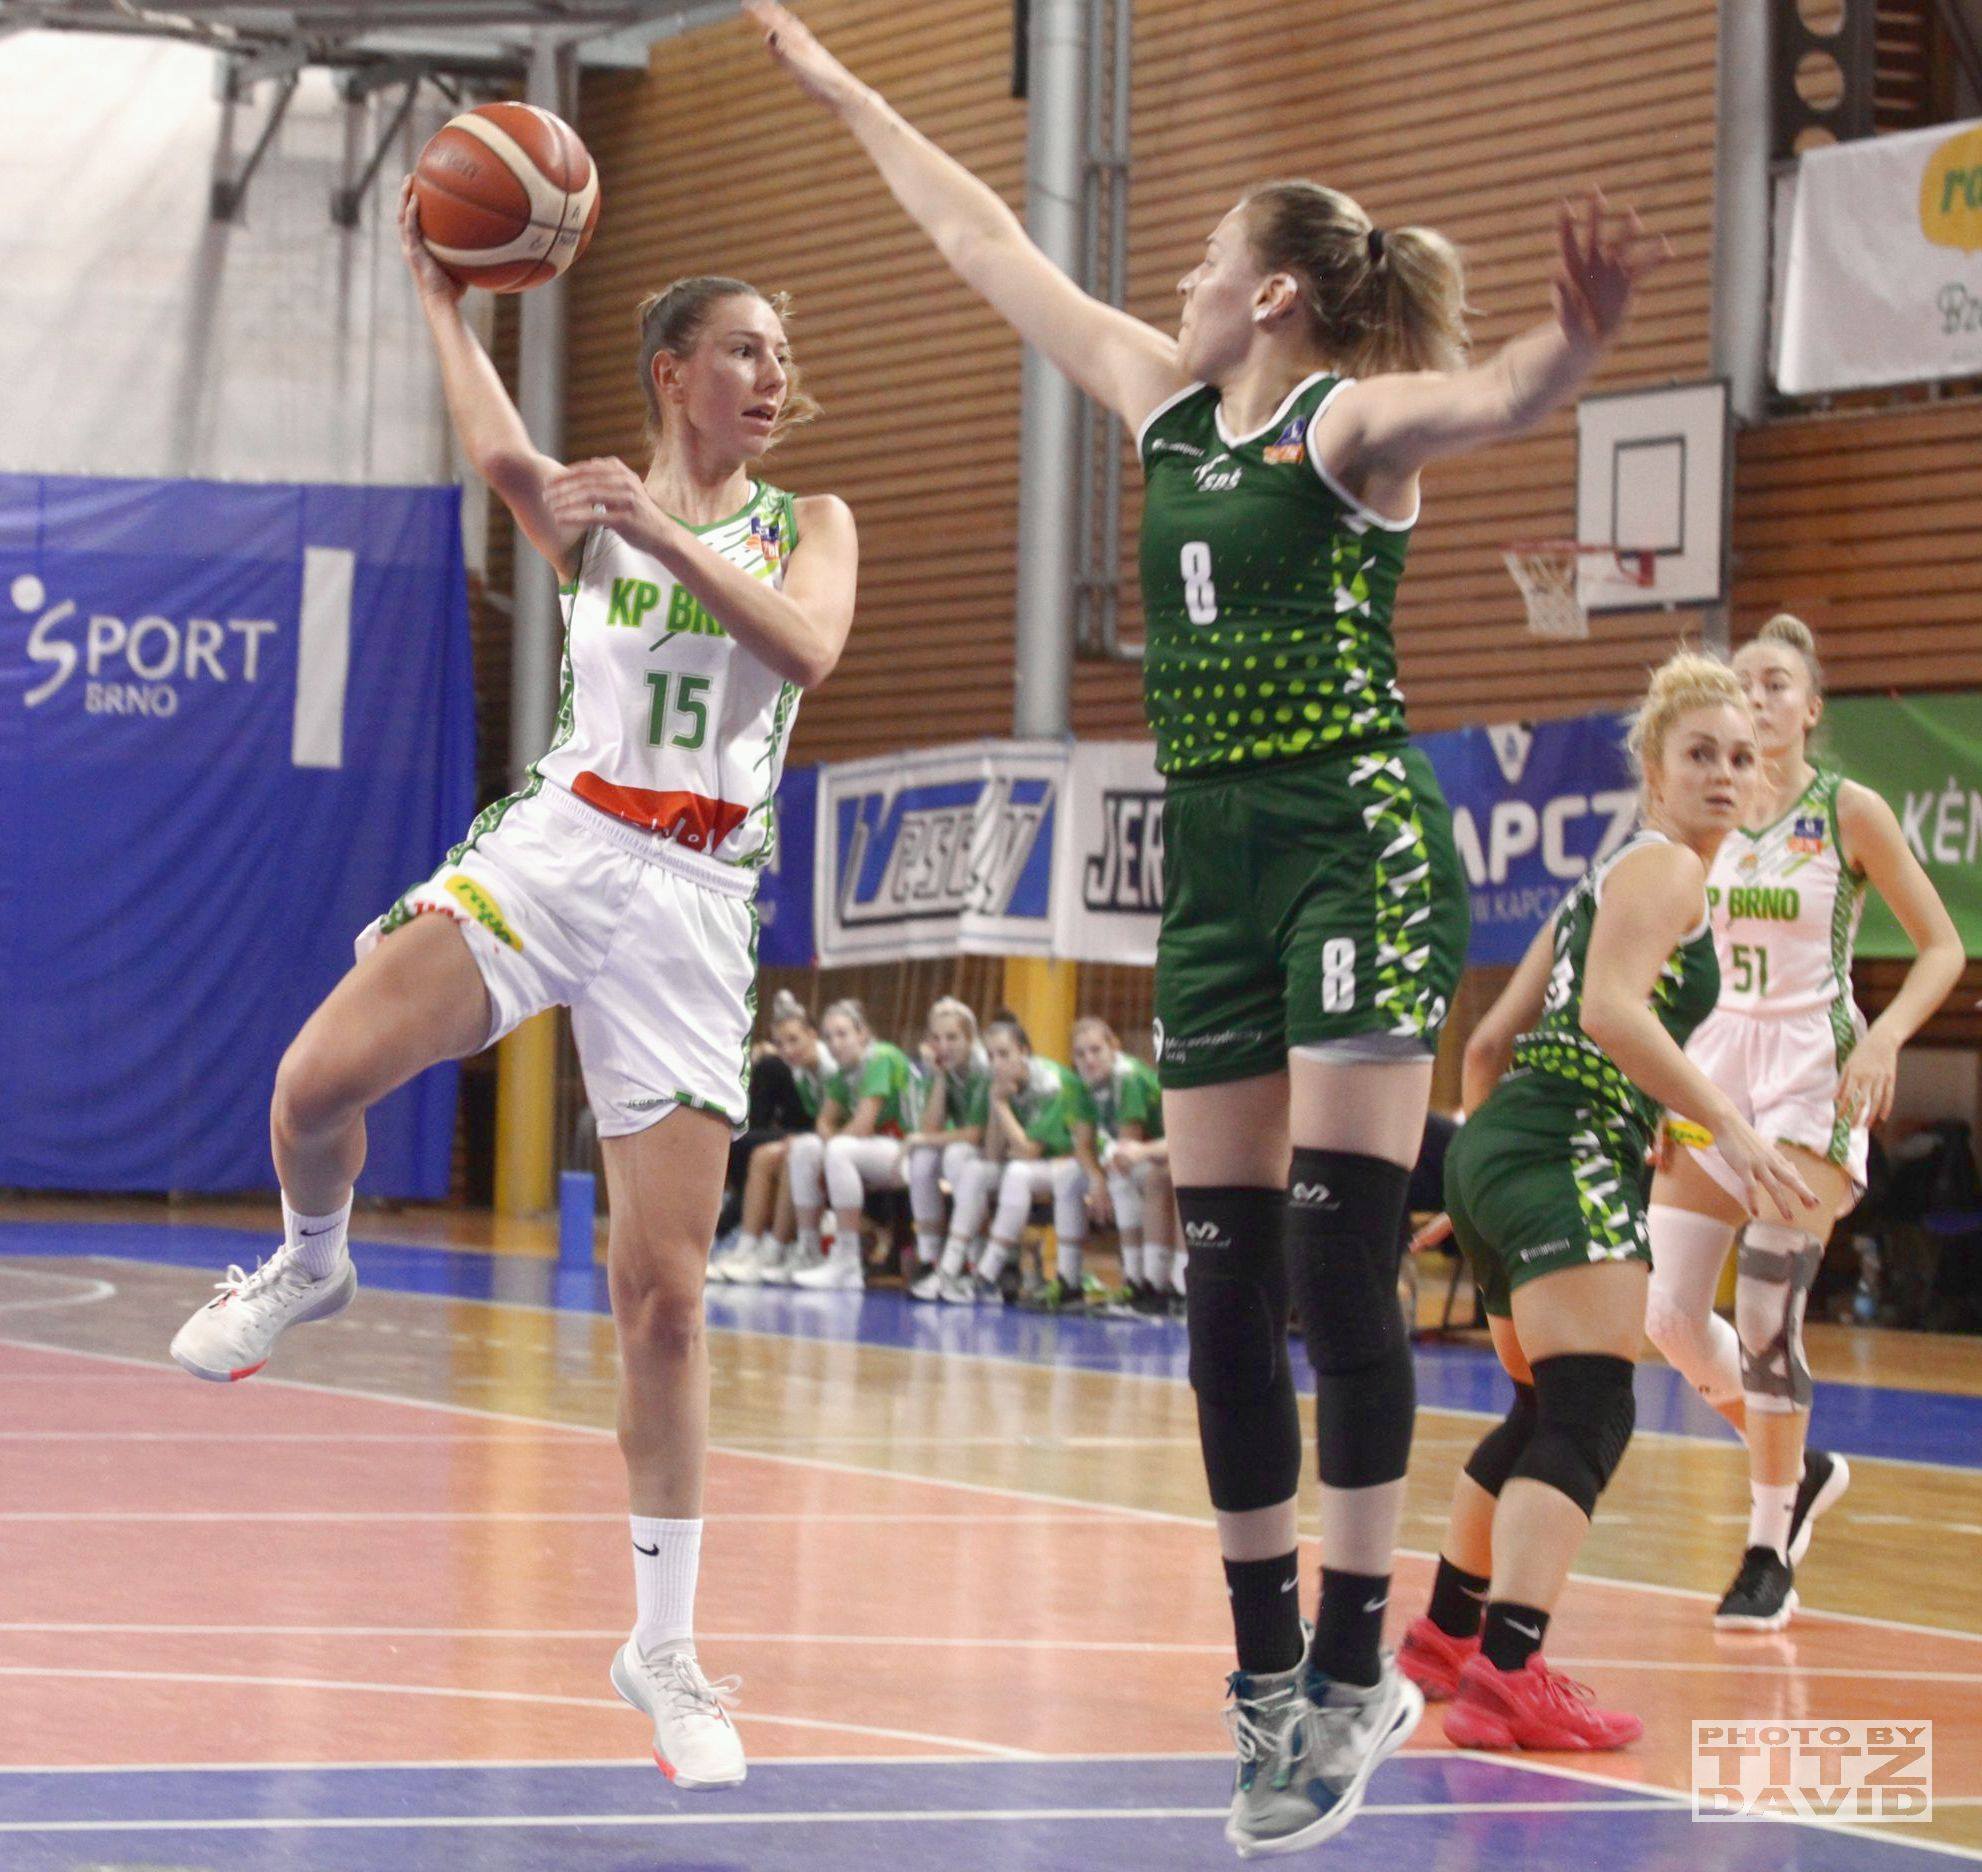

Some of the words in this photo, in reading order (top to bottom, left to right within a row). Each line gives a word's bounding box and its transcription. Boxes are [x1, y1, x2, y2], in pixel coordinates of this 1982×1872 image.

[607, 577, 662, 628] KP
[665, 582, 727, 637] BR
[1180, 541, 1218, 626] 8
[25, 598, 278, 707] SPORT
[85, 684, 178, 718] BRNO
[643, 669, 713, 751] 15
[1728, 885, 1799, 921] BRNO
[1322, 937, 1357, 1014] 8
[1731, 944, 1768, 997] 51
